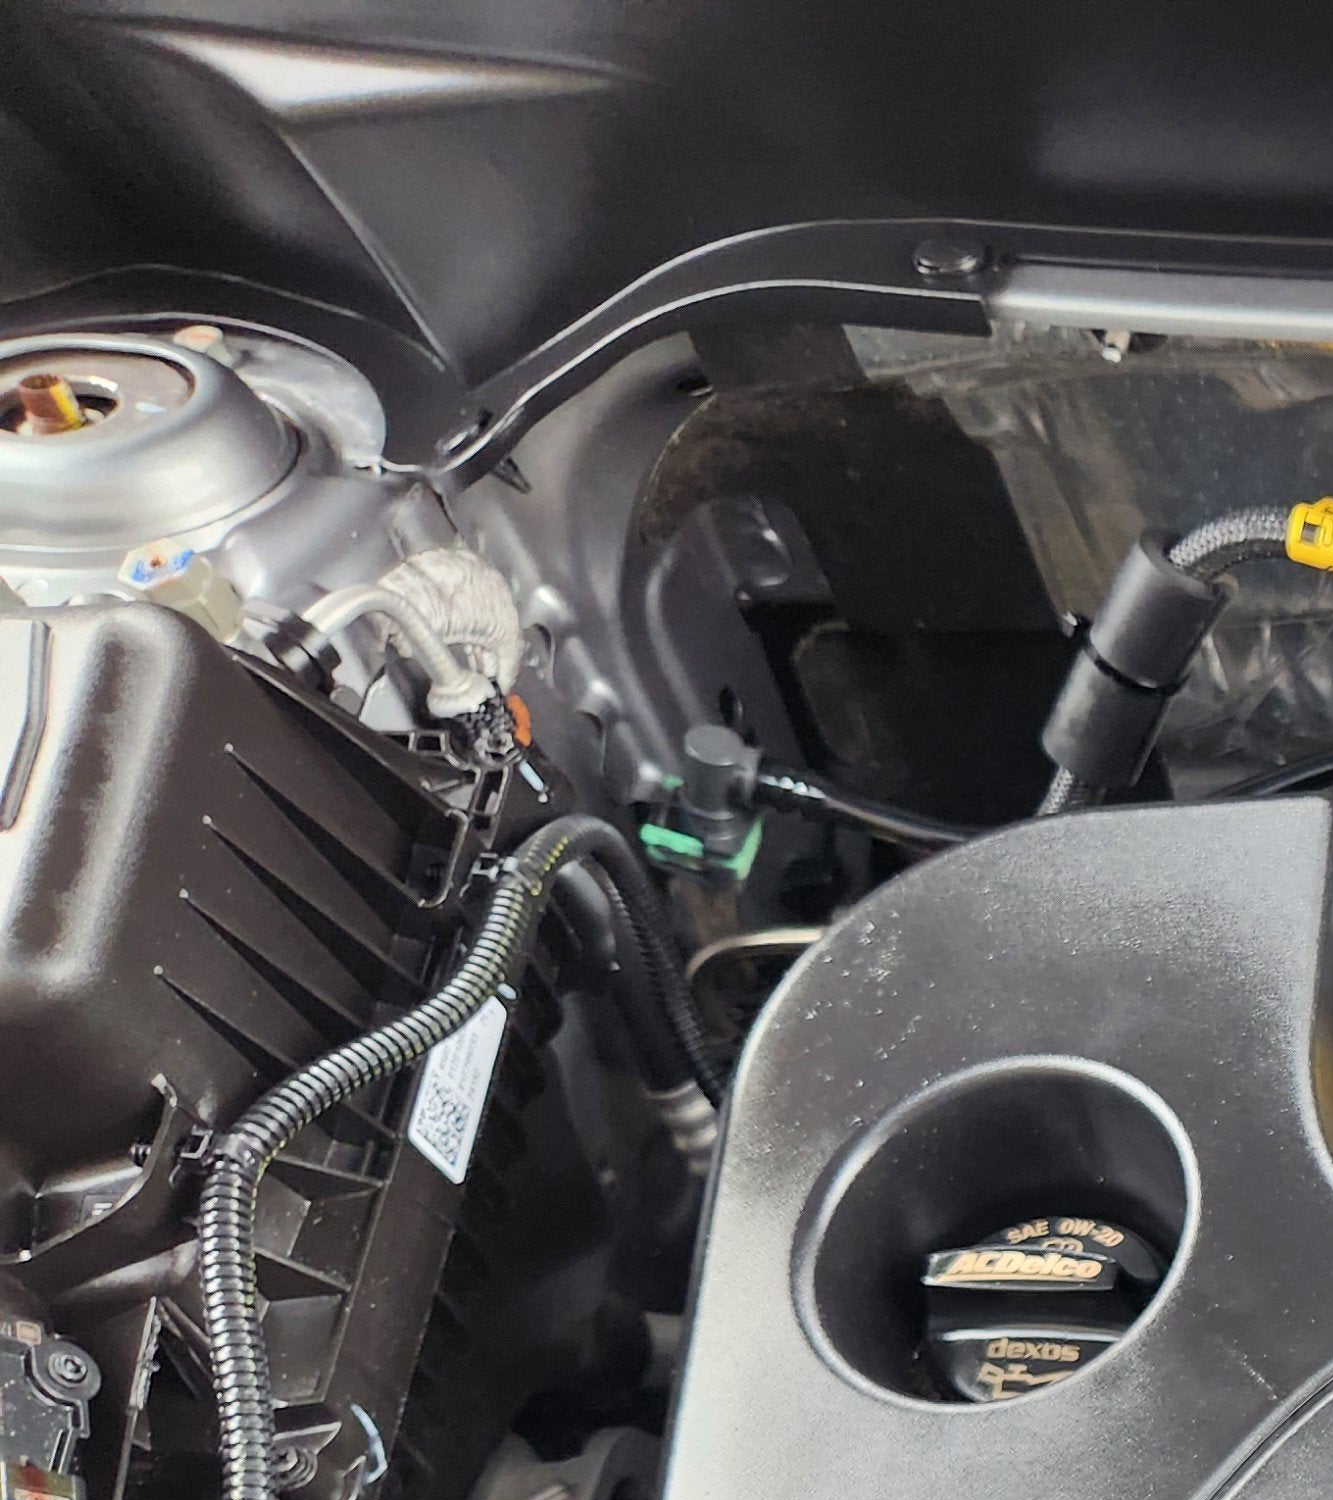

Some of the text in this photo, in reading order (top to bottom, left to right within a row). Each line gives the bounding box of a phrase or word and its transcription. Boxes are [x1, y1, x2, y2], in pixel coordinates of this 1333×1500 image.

[1006, 1217, 1125, 1248] SAE 0W-20
[949, 1250, 1103, 1279] ACDelco
[987, 1338, 1081, 1362] dexos
